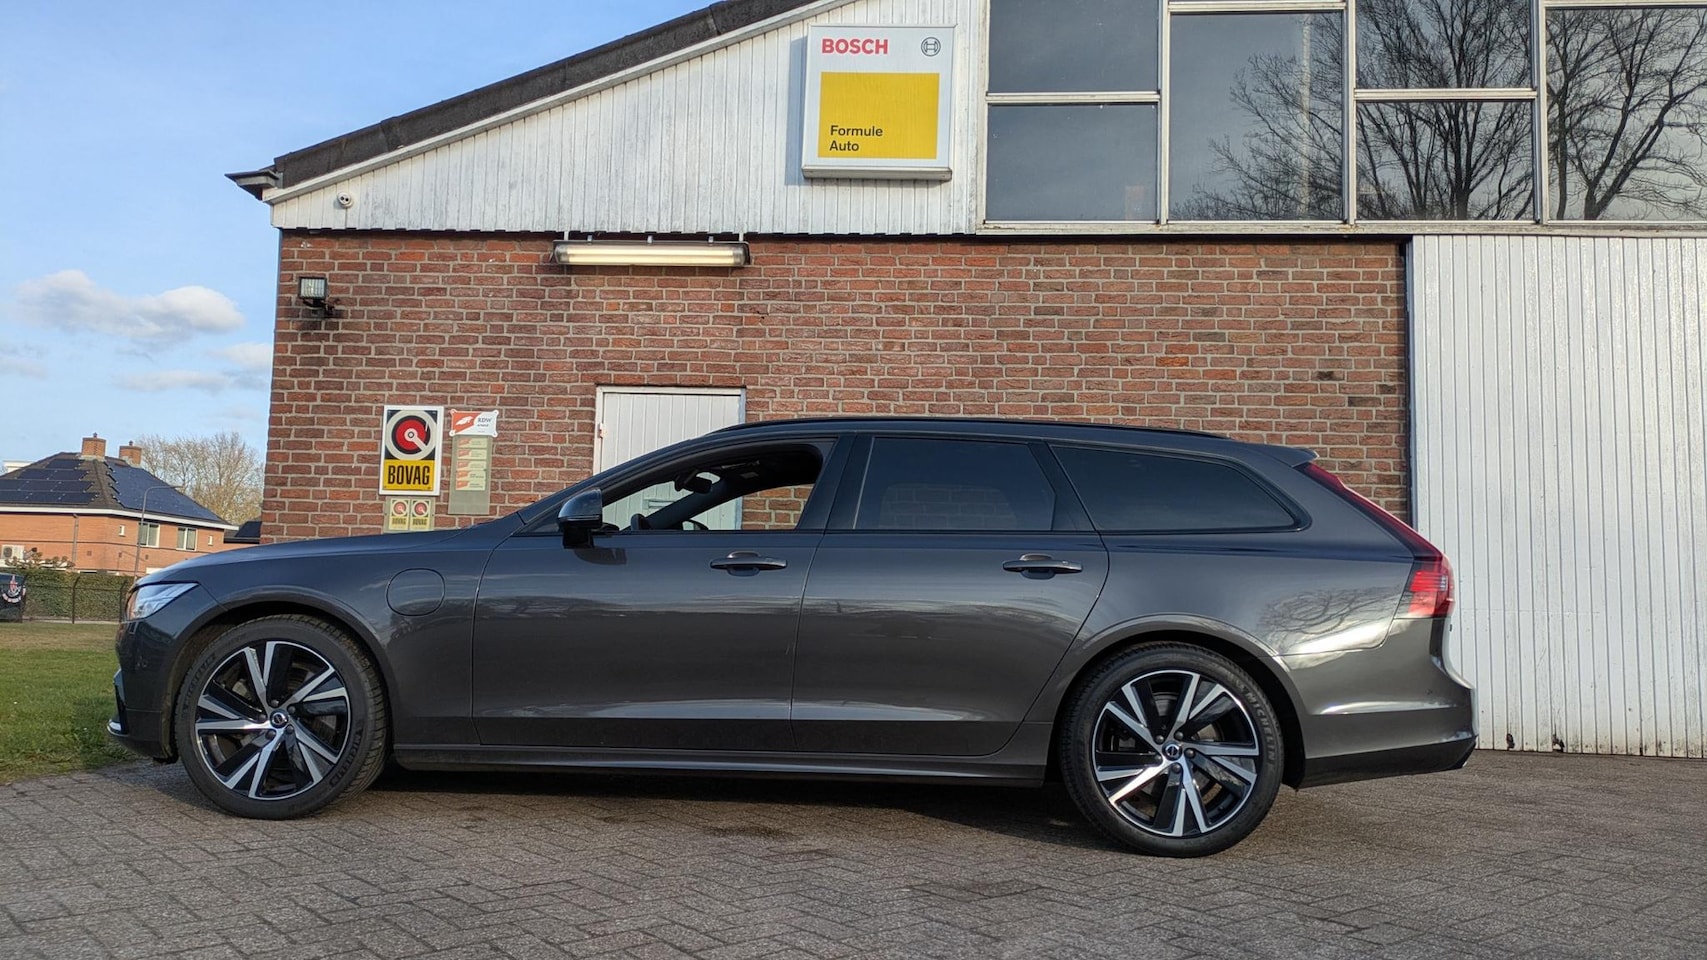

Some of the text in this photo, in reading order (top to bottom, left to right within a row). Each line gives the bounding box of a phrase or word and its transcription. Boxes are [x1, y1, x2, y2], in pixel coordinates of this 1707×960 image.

[821, 38, 888, 55] BOSCH
[830, 125, 883, 137] Formule
[829, 140, 860, 152] Auto
[388, 465, 429, 485] BOVAG
[1245, 690, 1275, 764] MICHELIN
